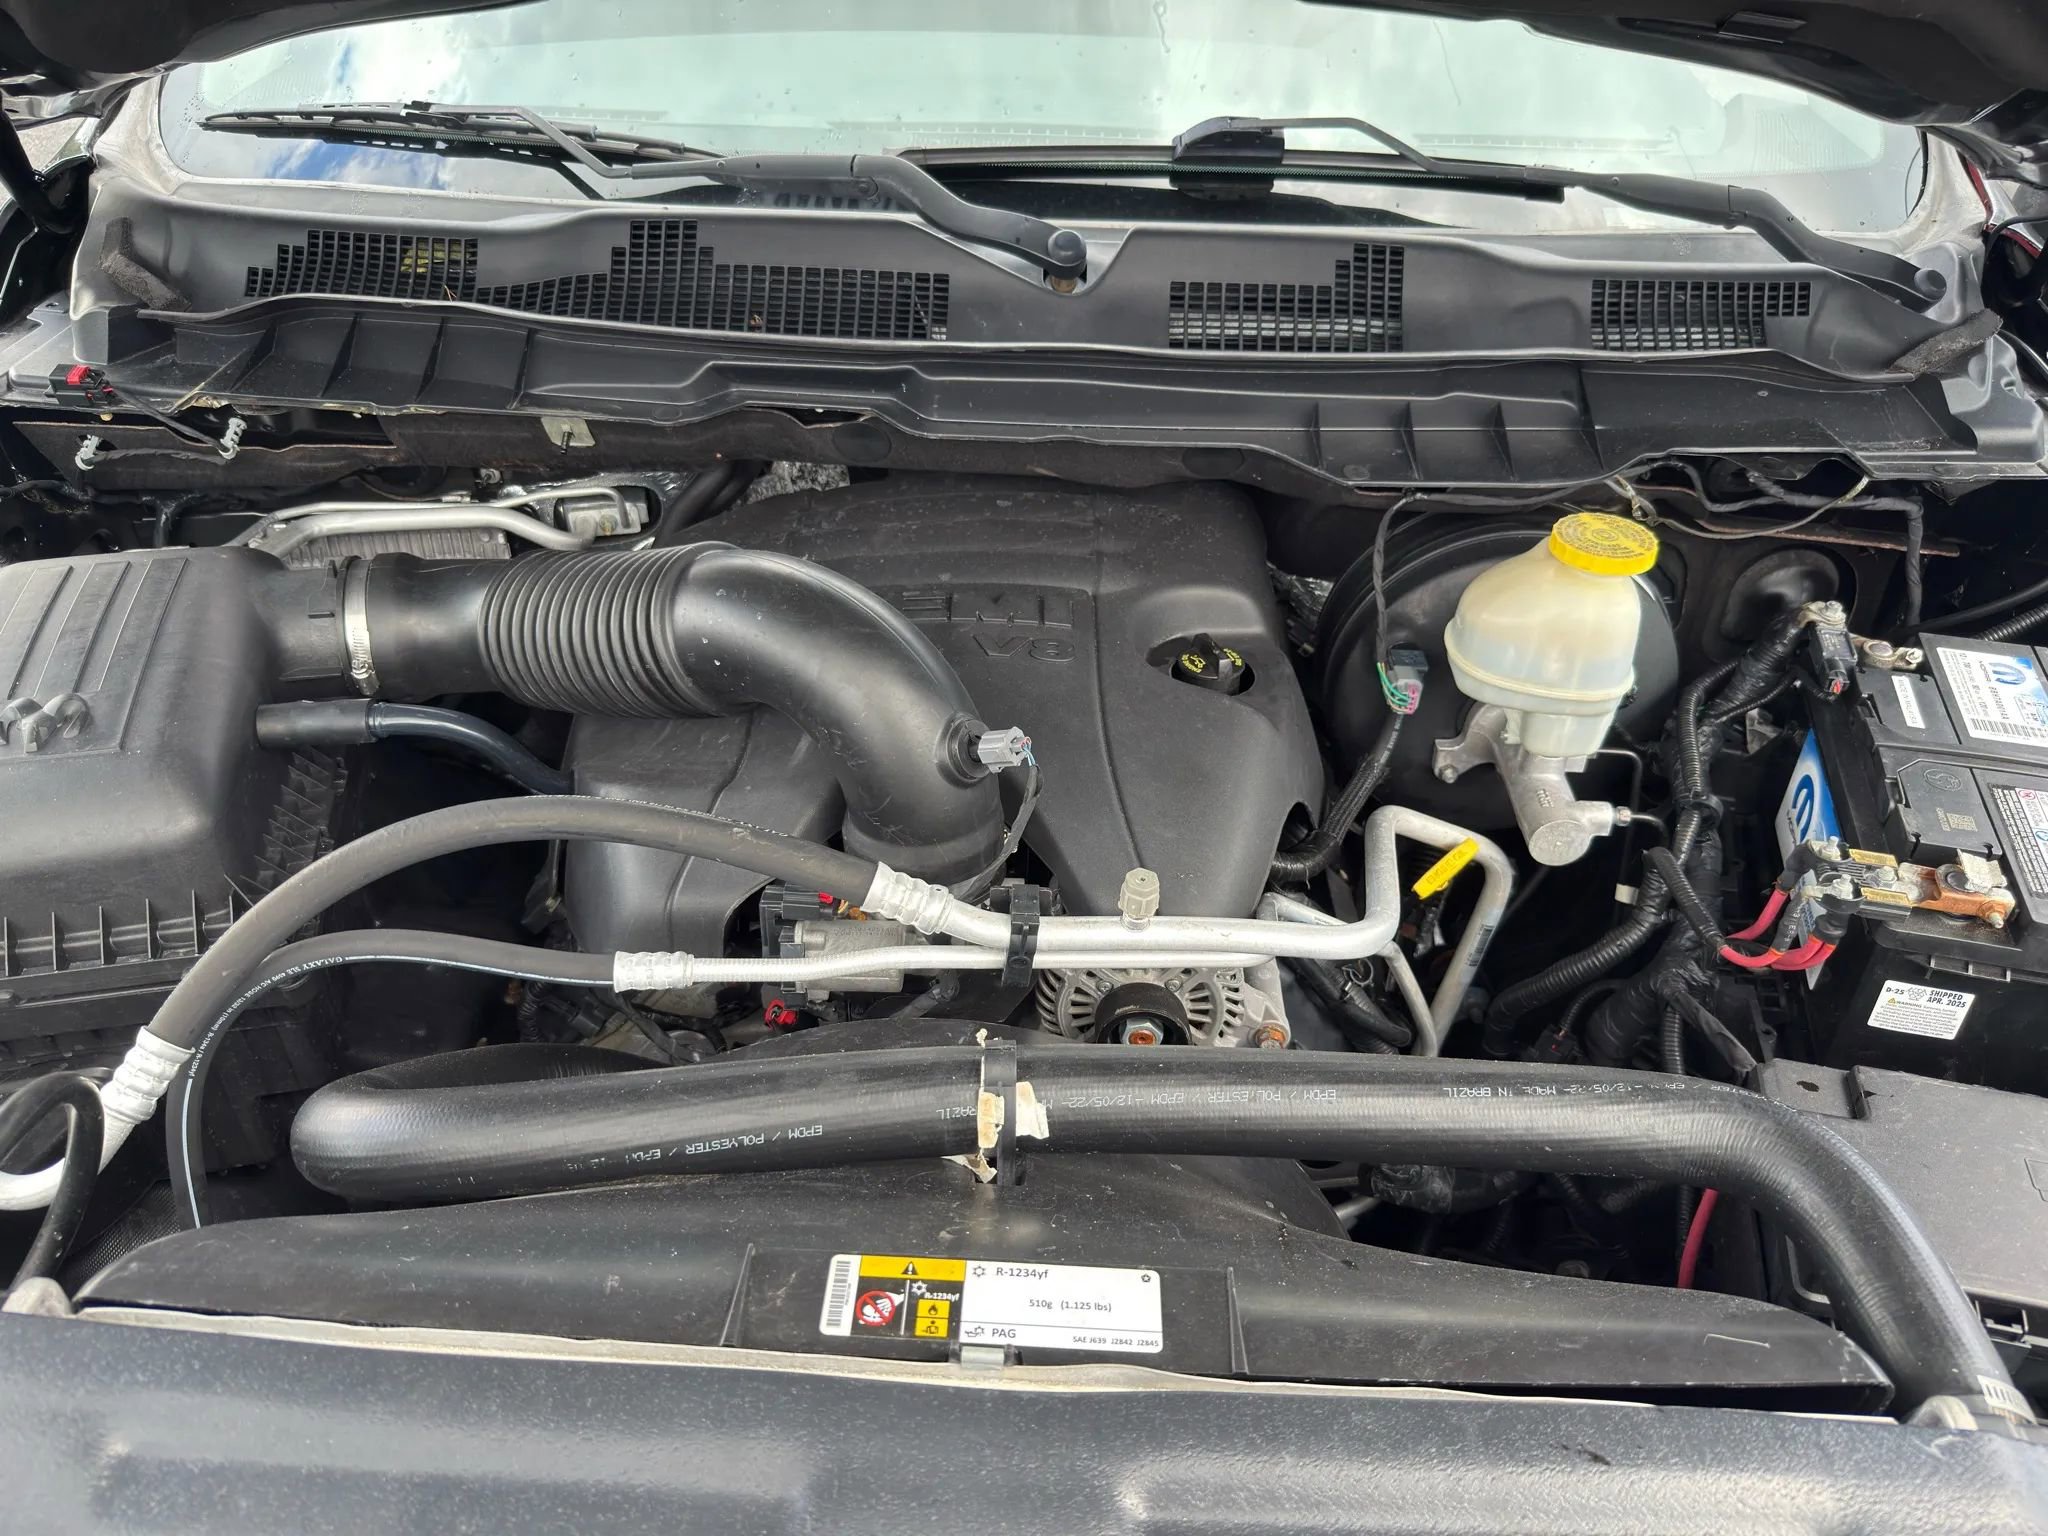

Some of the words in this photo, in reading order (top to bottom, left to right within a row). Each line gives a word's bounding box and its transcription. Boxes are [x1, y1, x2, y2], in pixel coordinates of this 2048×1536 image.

[971, 634, 1077, 664] V8
[302, 956, 343, 971] GALAXY
[1886, 987, 1905, 995] D-25
[1929, 990, 1963, 1000] SHIPPED
[1927, 996, 1944, 1005] APR.
[1946, 1000, 1967, 1008] 2025
[1151, 1092, 1184, 1104] EPDM
[1304, 1089, 1336, 1101] EPDM
[1443, 1087, 1491, 1098] BRAZIL
[936, 1105, 978, 1121] RAZIL
[788, 1124, 823, 1139] EPDM
[685, 1132, 765, 1155] POLYESTER
[996, 1267, 1049, 1280] R-1234yf
[924, 1292, 960, 1302] R-1234yf
[1029, 1299, 1053, 1310] 510g
[1060, 1300, 1091, 1311] (1.125
[1094, 1302, 1112, 1312] lbs)
[991, 1328, 1017, 1339] PAG
[1110, 1338, 1133, 1346] J2842
[1137, 1339, 1160, 1347] J2845
